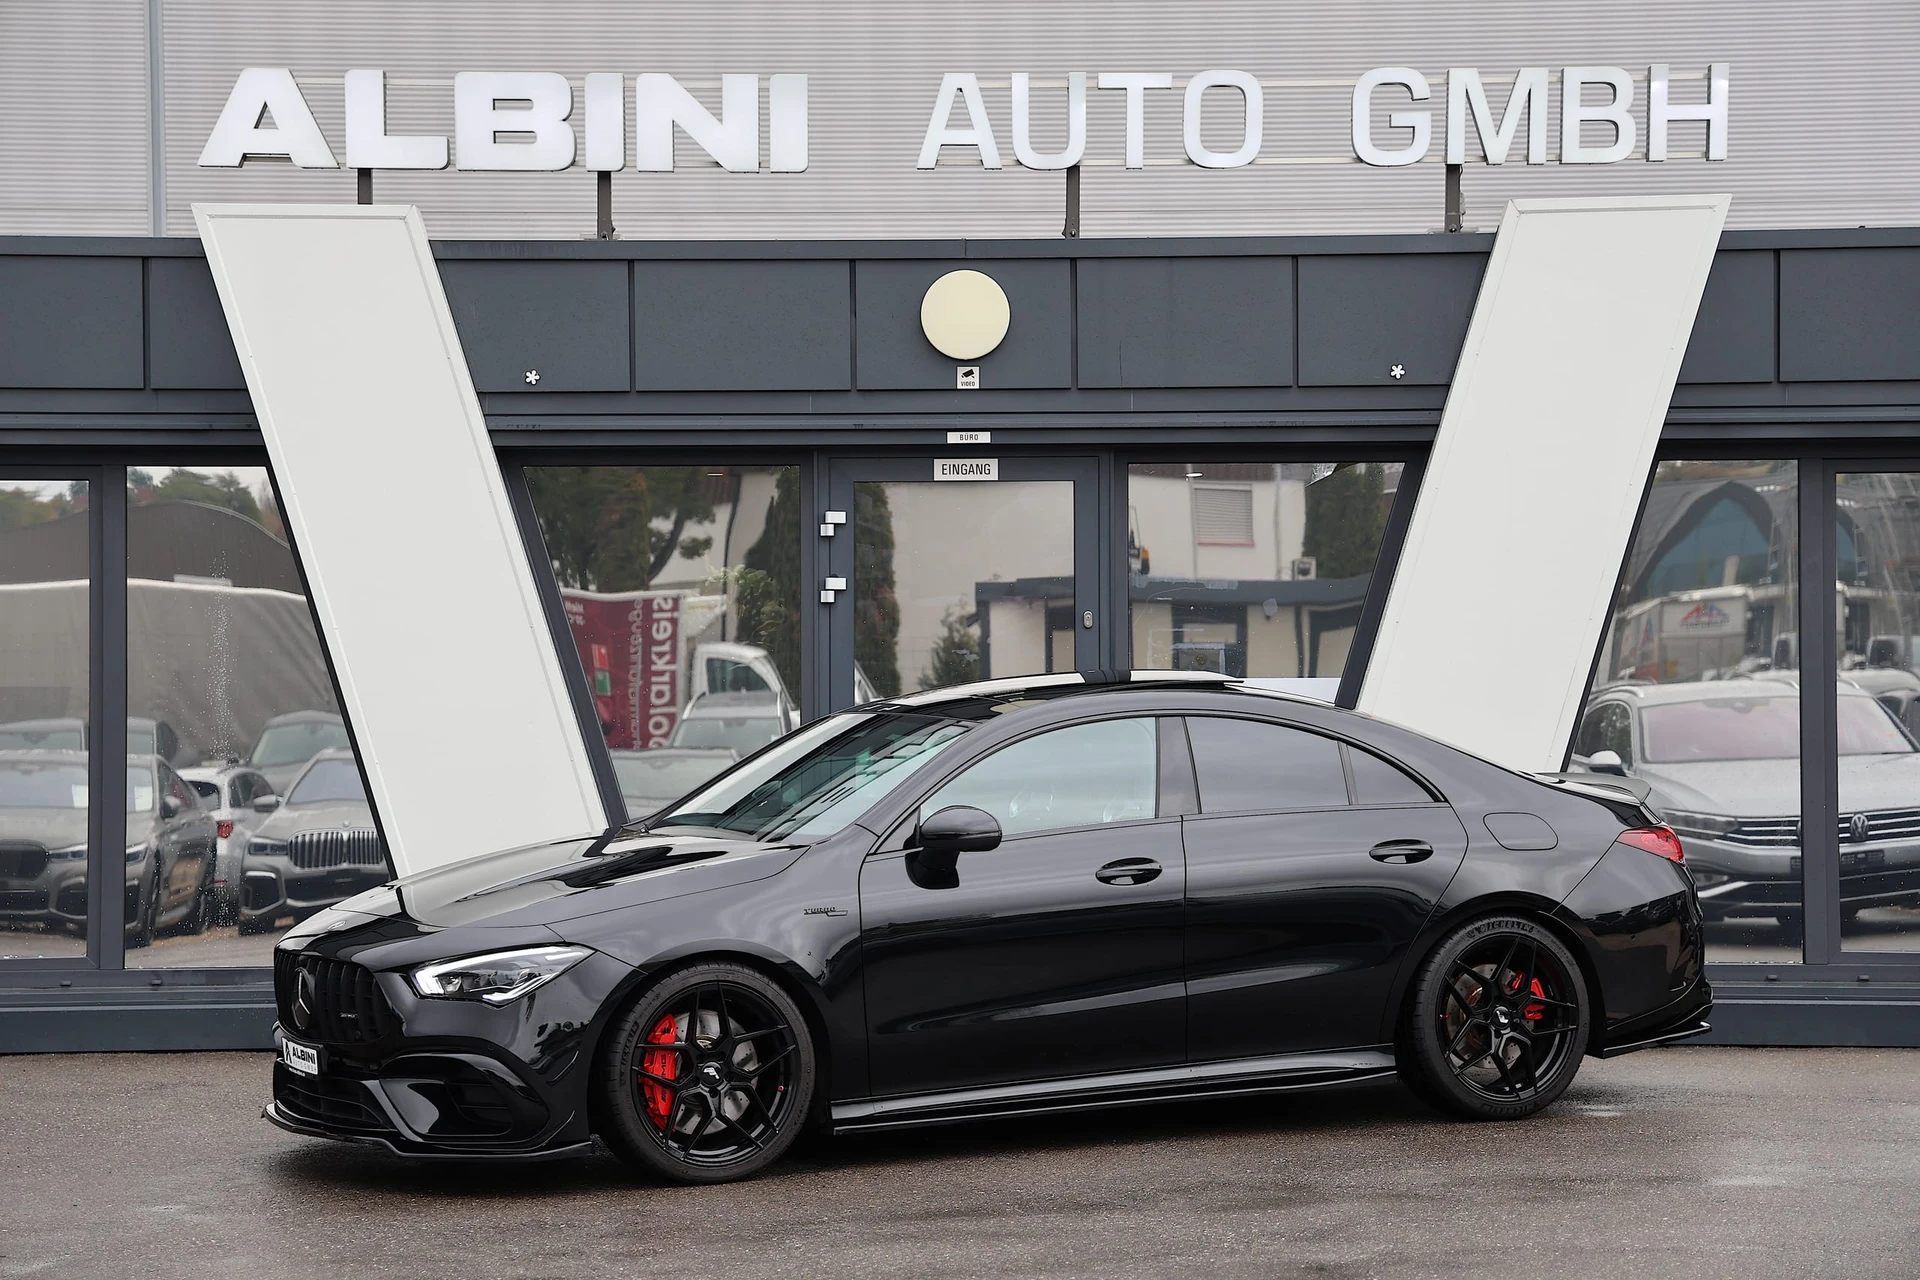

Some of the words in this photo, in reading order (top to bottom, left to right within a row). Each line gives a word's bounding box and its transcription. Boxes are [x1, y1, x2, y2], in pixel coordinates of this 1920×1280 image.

[198, 67, 810, 173] ALBINI
[917, 70, 1264, 170] AUTO
[1351, 62, 1729, 167] GMBH
[959, 433, 979, 441] BÜRO
[941, 463, 991, 475] EINGANG
[292, 1046, 316, 1065] ALBINI
